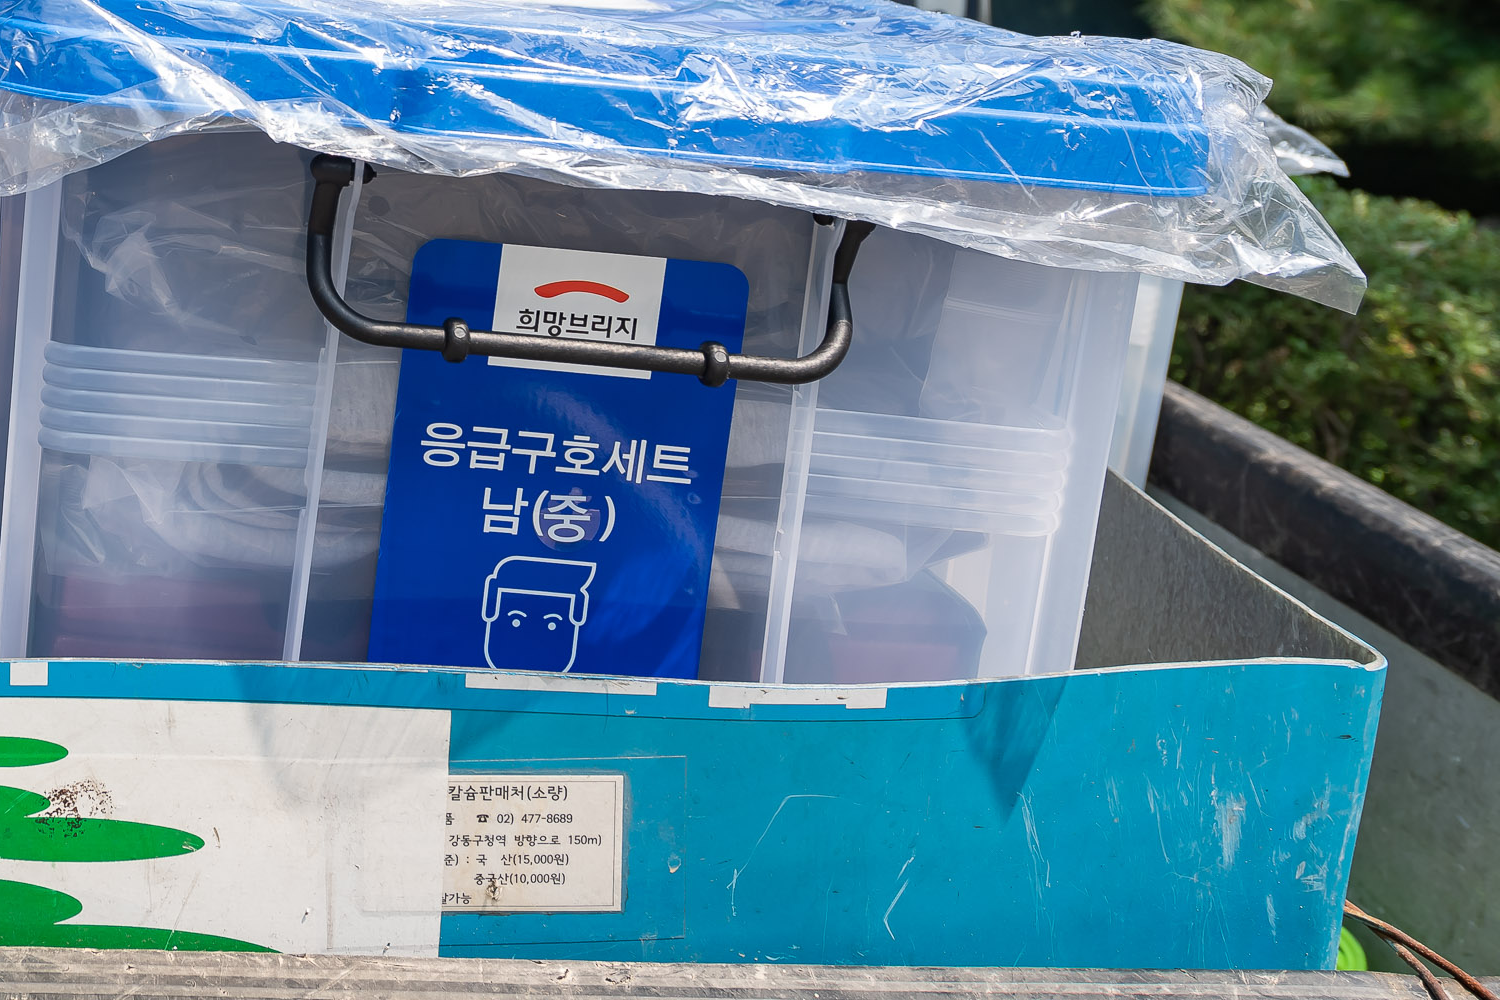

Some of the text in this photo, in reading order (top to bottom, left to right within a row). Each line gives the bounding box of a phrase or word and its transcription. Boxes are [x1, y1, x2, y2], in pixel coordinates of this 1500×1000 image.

[515, 308, 639, 340] 희망브리지
[420, 422, 692, 485] 응급구호세트
[482, 487, 616, 543] 남(중)
[496, 813, 515, 825] 02)
[521, 813, 573, 824] 477-8689
[448, 834, 602, 847] 강동구청역 방향으로 150m)
[473, 873, 566, 886] 중국산(10,000원)
